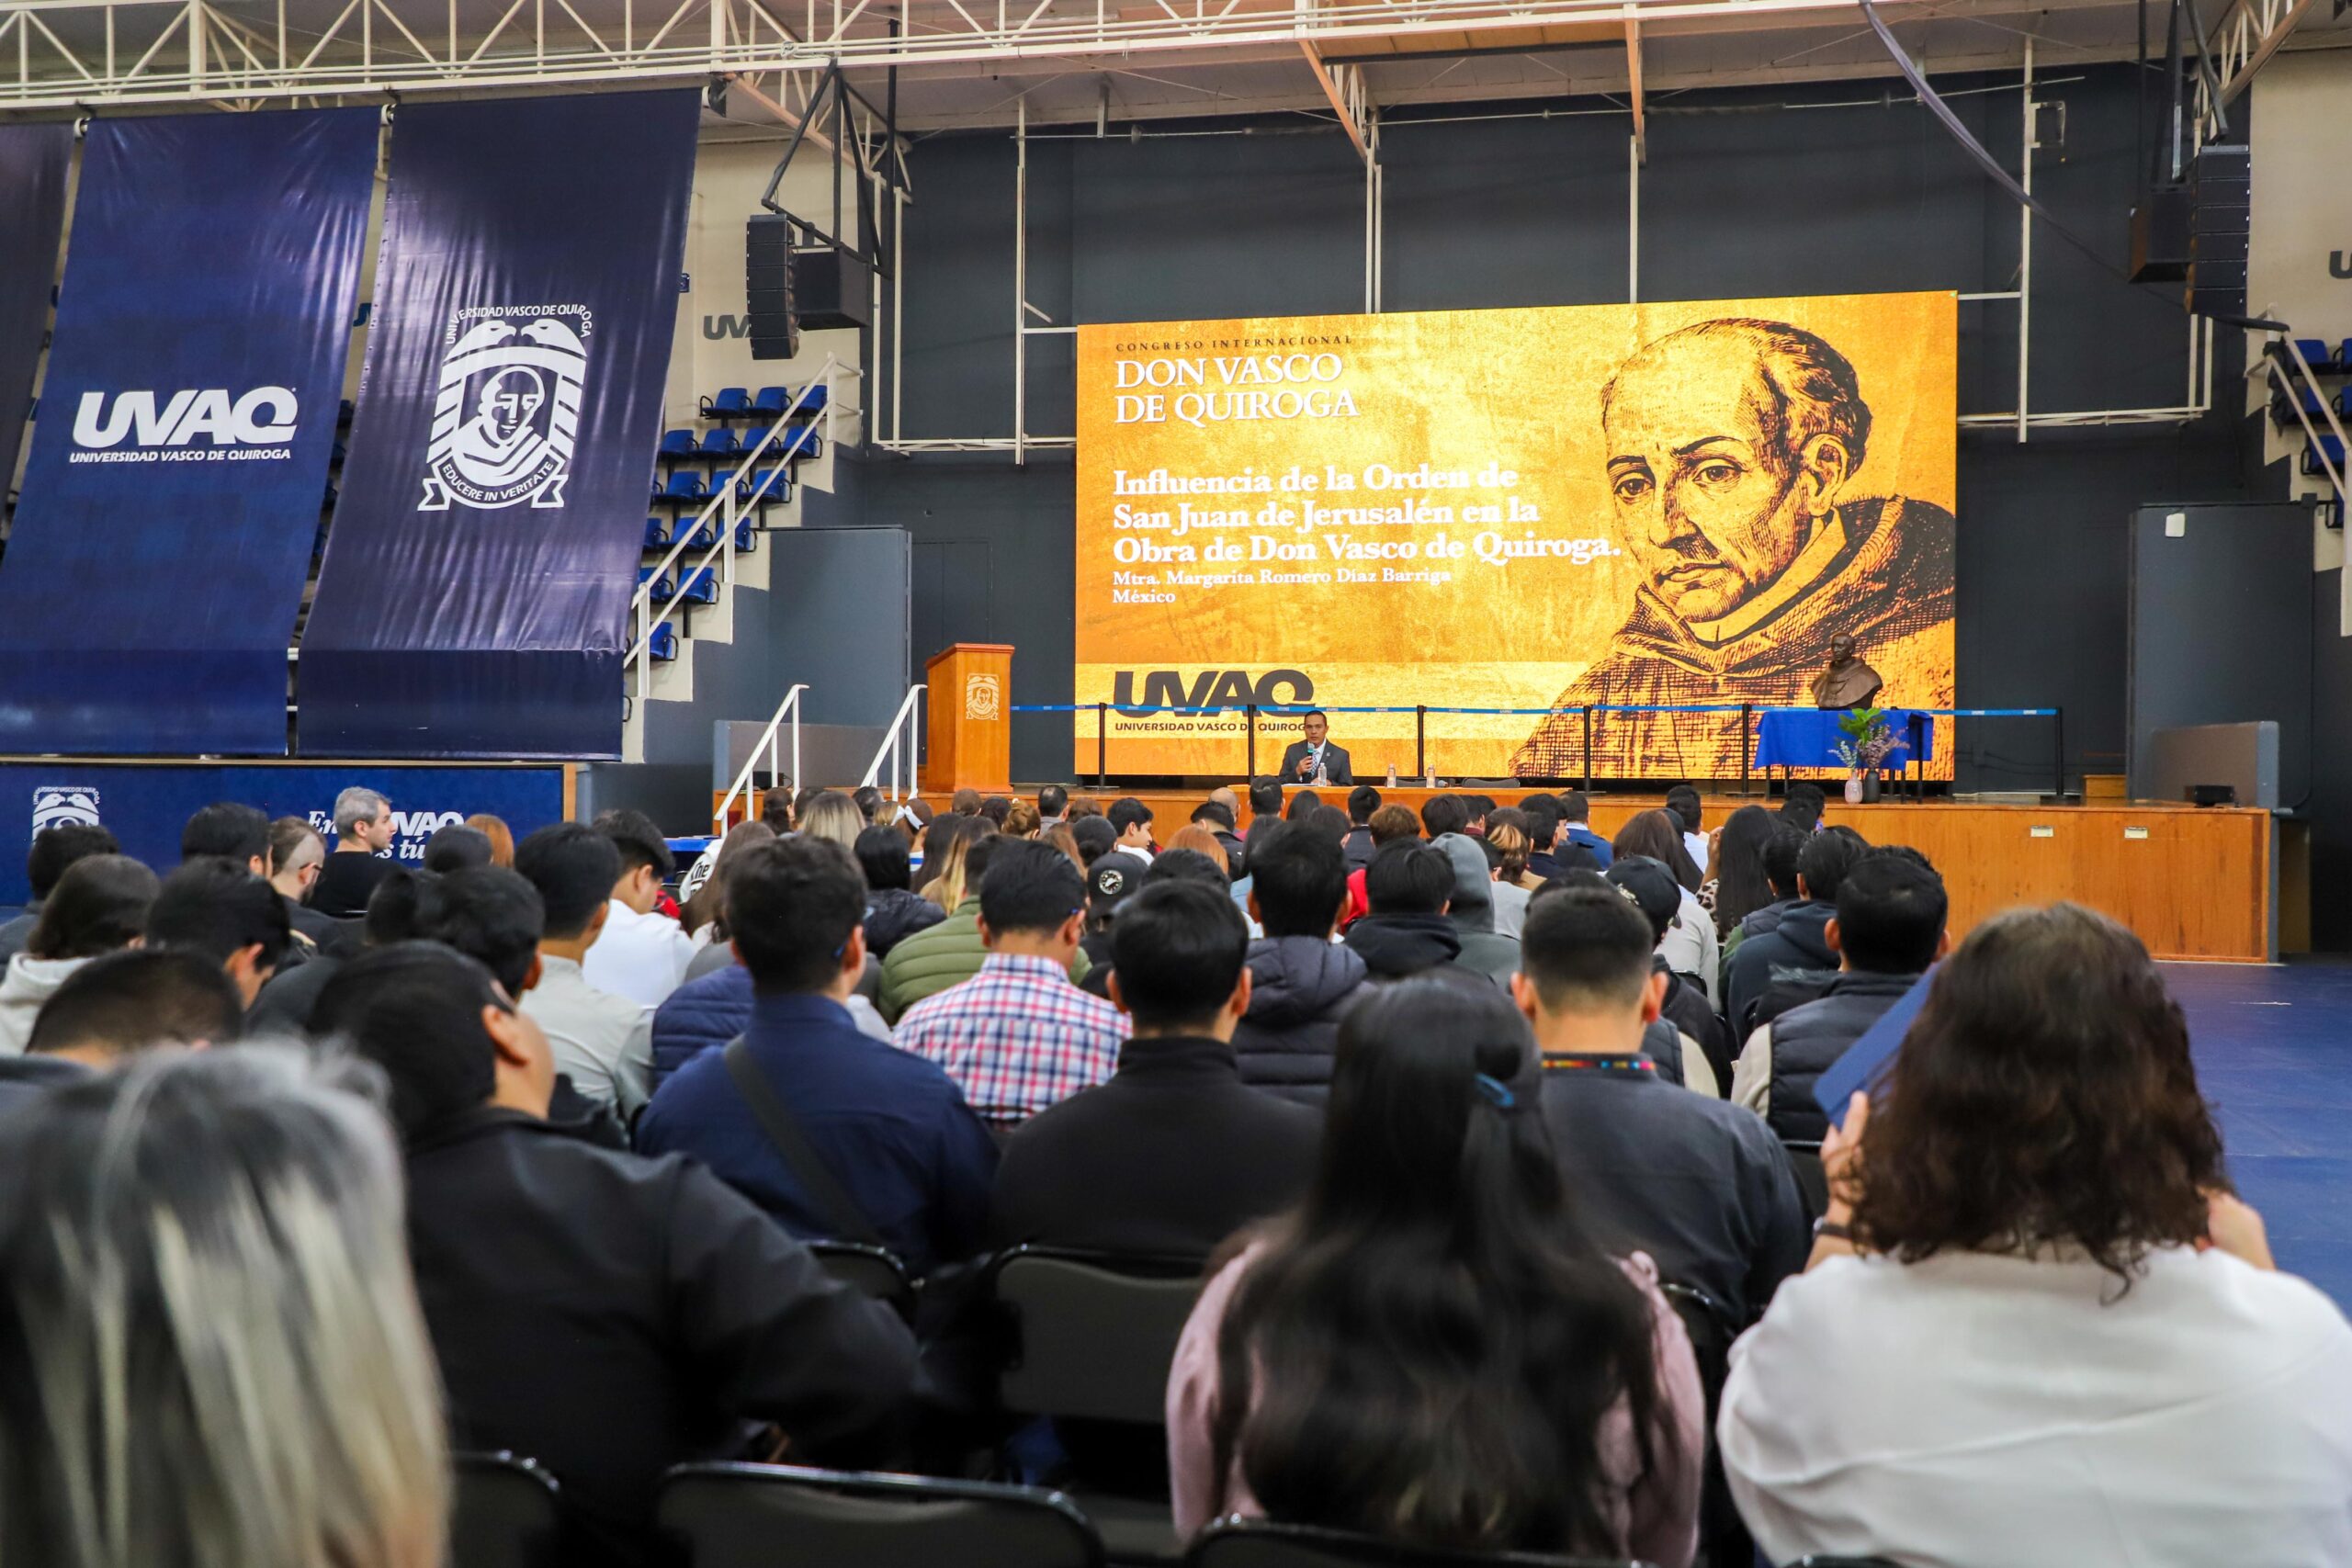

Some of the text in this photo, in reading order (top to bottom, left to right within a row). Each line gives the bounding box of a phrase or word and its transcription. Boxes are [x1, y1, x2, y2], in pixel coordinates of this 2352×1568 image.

[446, 304, 593, 344] UNIVERSIDAD VASCO DE QUIROGA
[1115, 335, 1353, 352] CONGRESO INTERNACIONAL
[1114, 353, 1343, 389] DON VASCO
[73, 386, 298, 448] UVAQ
[1114, 389, 1361, 429] DE QUIROGA
[70, 448, 291, 464] UNIVERSIDAD VASCO DE QUIROGA
[442, 461, 554, 502] EDUCERE IN VERITATE
[1113, 460, 1519, 496] Influencia de la Orden de
[1113, 496, 1542, 537] San Juan de Jerusalén en la
[1113, 531, 1623, 567] Obra de Don Vasco de Quiroga.
[1113, 567, 1453, 590] Mtra. Margarita Romero Díaz Barriga
[1113, 588, 1177, 604] México
[1114, 669, 1317, 718] UVAQ
[1114, 722, 1194, 732] UNIVERSIDAD
[1196, 722, 1238, 732] VASCO
[1258, 722, 1306, 732] QUIROG
